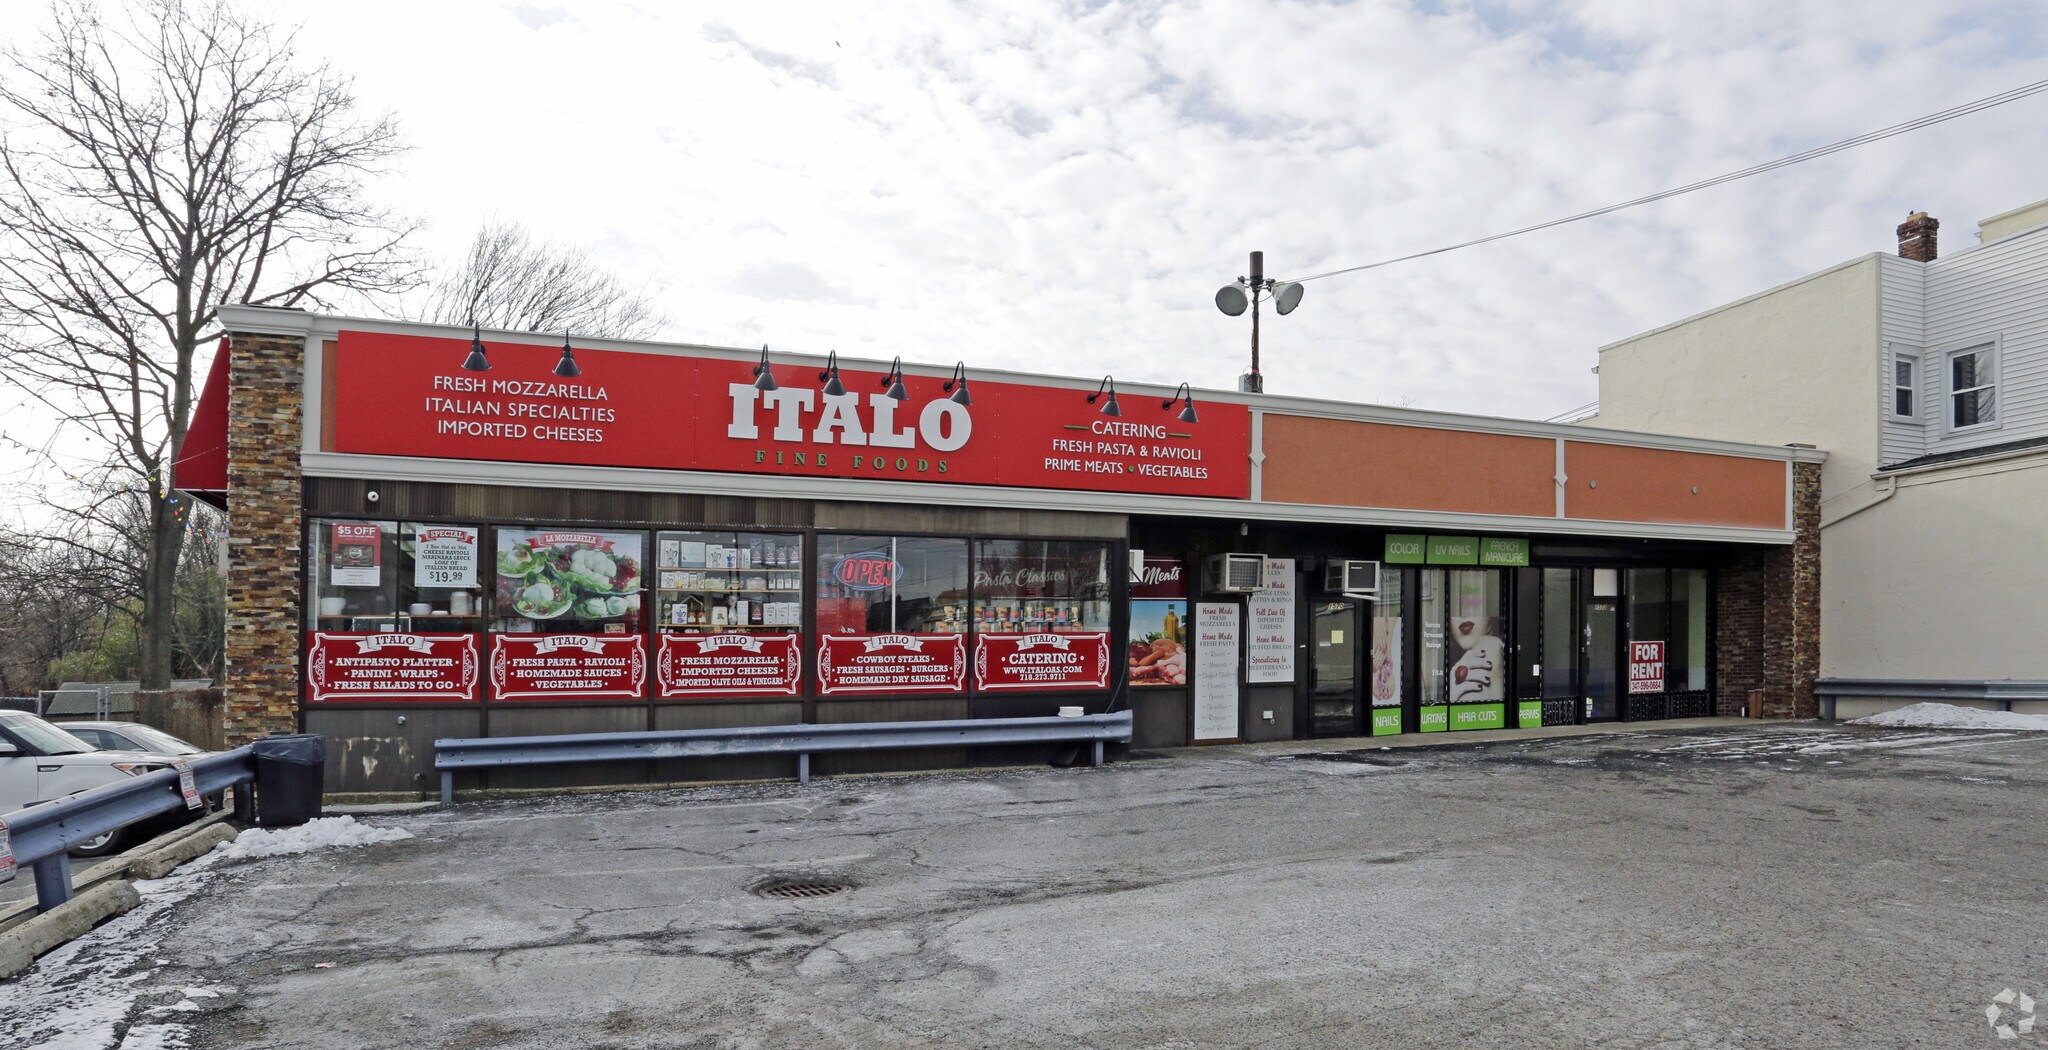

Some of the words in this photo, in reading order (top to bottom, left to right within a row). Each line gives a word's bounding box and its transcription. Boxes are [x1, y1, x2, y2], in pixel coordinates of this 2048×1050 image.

[434, 376, 486, 392] FRESH
[492, 380, 608, 400] MOZZARELLA
[426, 398, 500, 415] ITALIAN
[508, 403, 615, 422] SPECIALTIES
[728, 383, 972, 451] ITALO
[438, 420, 526, 438] IMPORTED
[533, 426, 603, 442] CHEESES
[1092, 421, 1166, 439] CATERING
[1053, 439, 1092, 453] FRESH
[1097, 443, 1135, 456] PASTA
[1140, 446, 1148, 457] &
[1153, 447, 1201, 460] RAVIOLI
[755, 450, 827, 467] FINE
[853, 456, 947, 473] FOODS
[1045, 458, 1080, 472] PRIME
[1085, 460, 1123, 474] MEATS
[1138, 464, 1207, 479] VEGETABLES
[338, 526, 350, 534] $5
[354, 527, 375, 535] OFF
[431, 530, 463, 538] SPECIAL
[556, 534, 596, 544] MOZZARELLA
[1390, 543, 1419, 554] COLOR
[1436, 545, 1447, 555] UV
[1449, 546, 1470, 556] NAILS
[1491, 541, 1518, 551] FRENCH
[1485, 553, 1523, 562] MANICURE
[430, 572, 462, 582] $19.99
[842, 559, 892, 586] OPEN
[1143, 566, 1182, 584] Meats
[974, 570, 1011, 589] Pasta
[1015, 568, 1065, 586] Classics
[375, 636, 415, 646] ITALO
[713, 637, 747, 645] ITALO
[1218, 632, 1232, 640] Made
[552, 637, 588, 646] ITALO
[1636, 644, 1658, 660] FOR
[336, 658, 400, 666] ANTIPASTO
[403, 658, 453, 666] PLATTER
[512, 659, 544, 667] FRESH
[584, 658, 626, 666] RAVIOLI
[680, 657, 711, 665] FRESH
[714, 656, 779, 664] MOZZARELLA
[857, 656, 895, 664] COWBOY
[1009, 653, 1077, 664] CATERING
[351, 670, 392, 678] PANINI
[399, 670, 438, 678] WRAPS
[516, 669, 582, 678] HOMEMADE
[584, 669, 622, 677] SAUCES
[681, 668, 735, 676] IMPORTED
[737, 667, 778, 675] CHEESES
[837, 666, 863, 674] FRESH
[1003, 666, 1082, 674] WWW.ITALOAS.COM
[1632, 662, 1662, 679] RENT
[334, 681, 370, 689] FRESH
[373, 681, 417, 689] SALADS
[418, 681, 433, 689] TO
[436, 681, 453, 689] GO
[535, 681, 602, 689] VEGETABLES
[676, 679, 710, 687] IMPORTED
[712, 678, 731, 686] OLIVE
[752, 677, 783, 685] VINEGARS
[840, 676, 890, 684] HOMEMADE
[1632, 681, 1660, 690] 347-596-0684
[1422, 713, 1446, 724] WAXING
[1458, 711, 1476, 722] HAIR
[1479, 710, 1497, 721] CUTS
[1519, 709, 1539, 719] PERMS
[1376, 716, 1398, 727] NAILS
